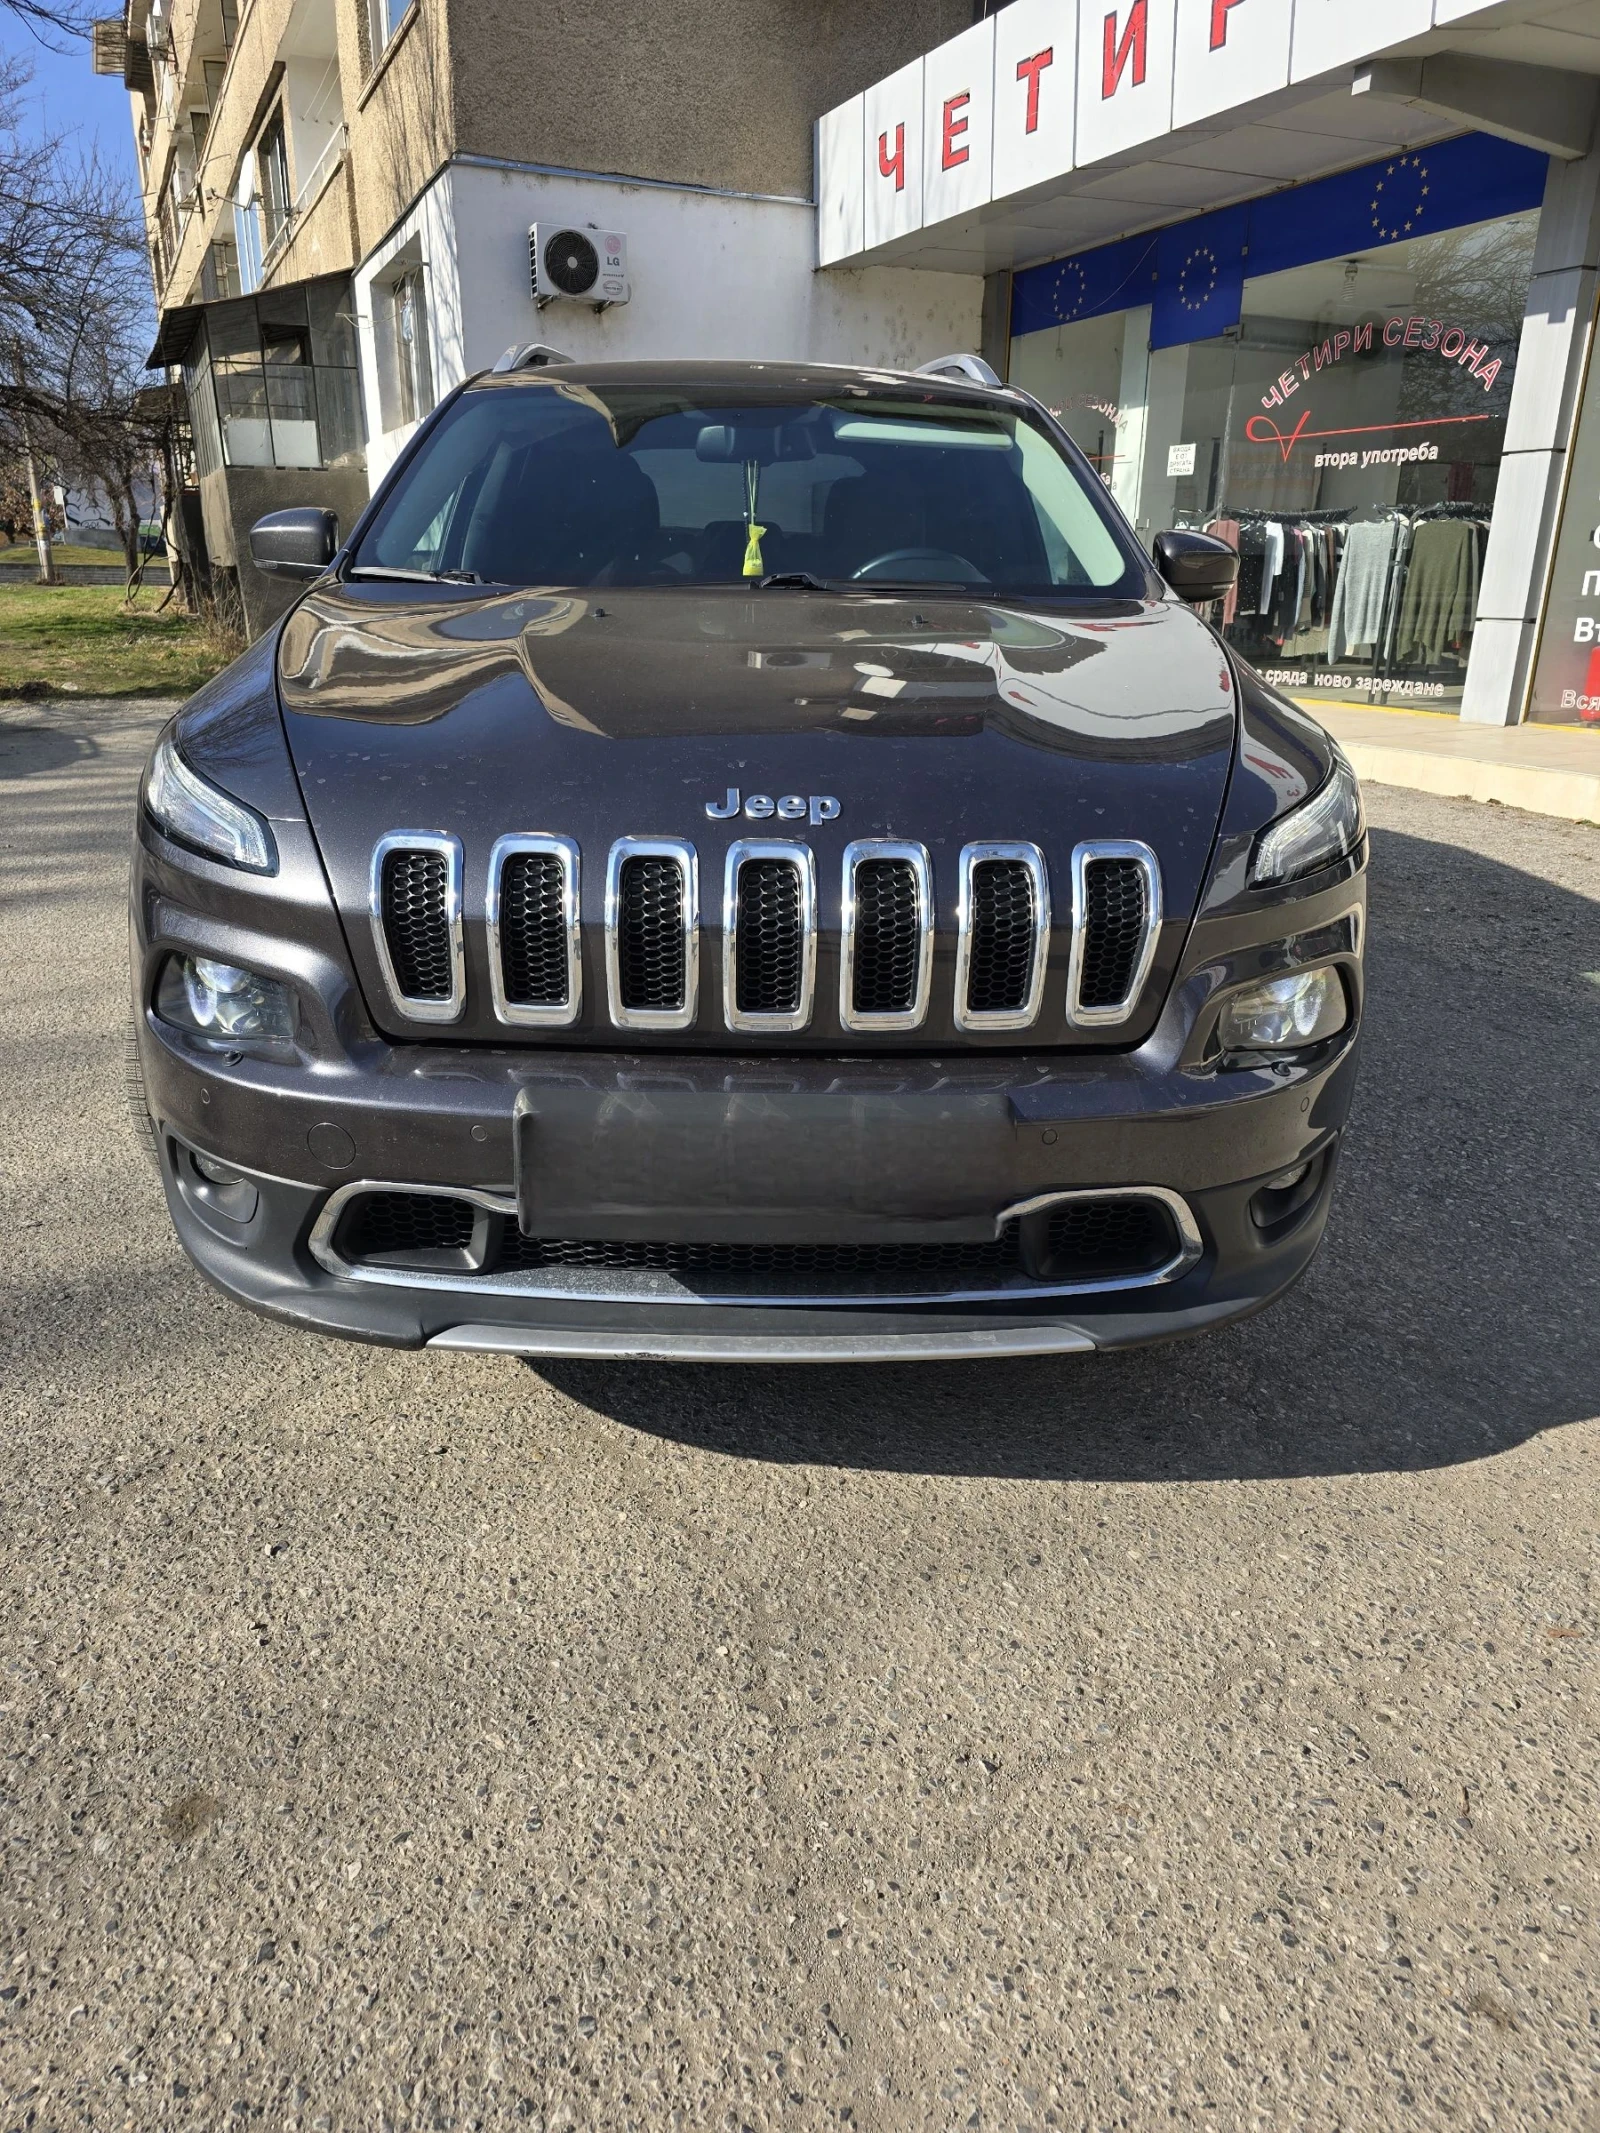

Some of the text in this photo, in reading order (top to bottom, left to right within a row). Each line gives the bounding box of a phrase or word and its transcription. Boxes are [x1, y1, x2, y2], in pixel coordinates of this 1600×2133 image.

[606, 256, 620, 267] LG
[1261, 316, 1503, 409] ЧЕТИРИ СЕЗОНА
[1314, 450, 1358, 470] втора
[1360, 441, 1439, 469] употреба
[1265, 669, 1445, 697] сряда ново зареждане
[705, 787, 842, 826] Jeep
